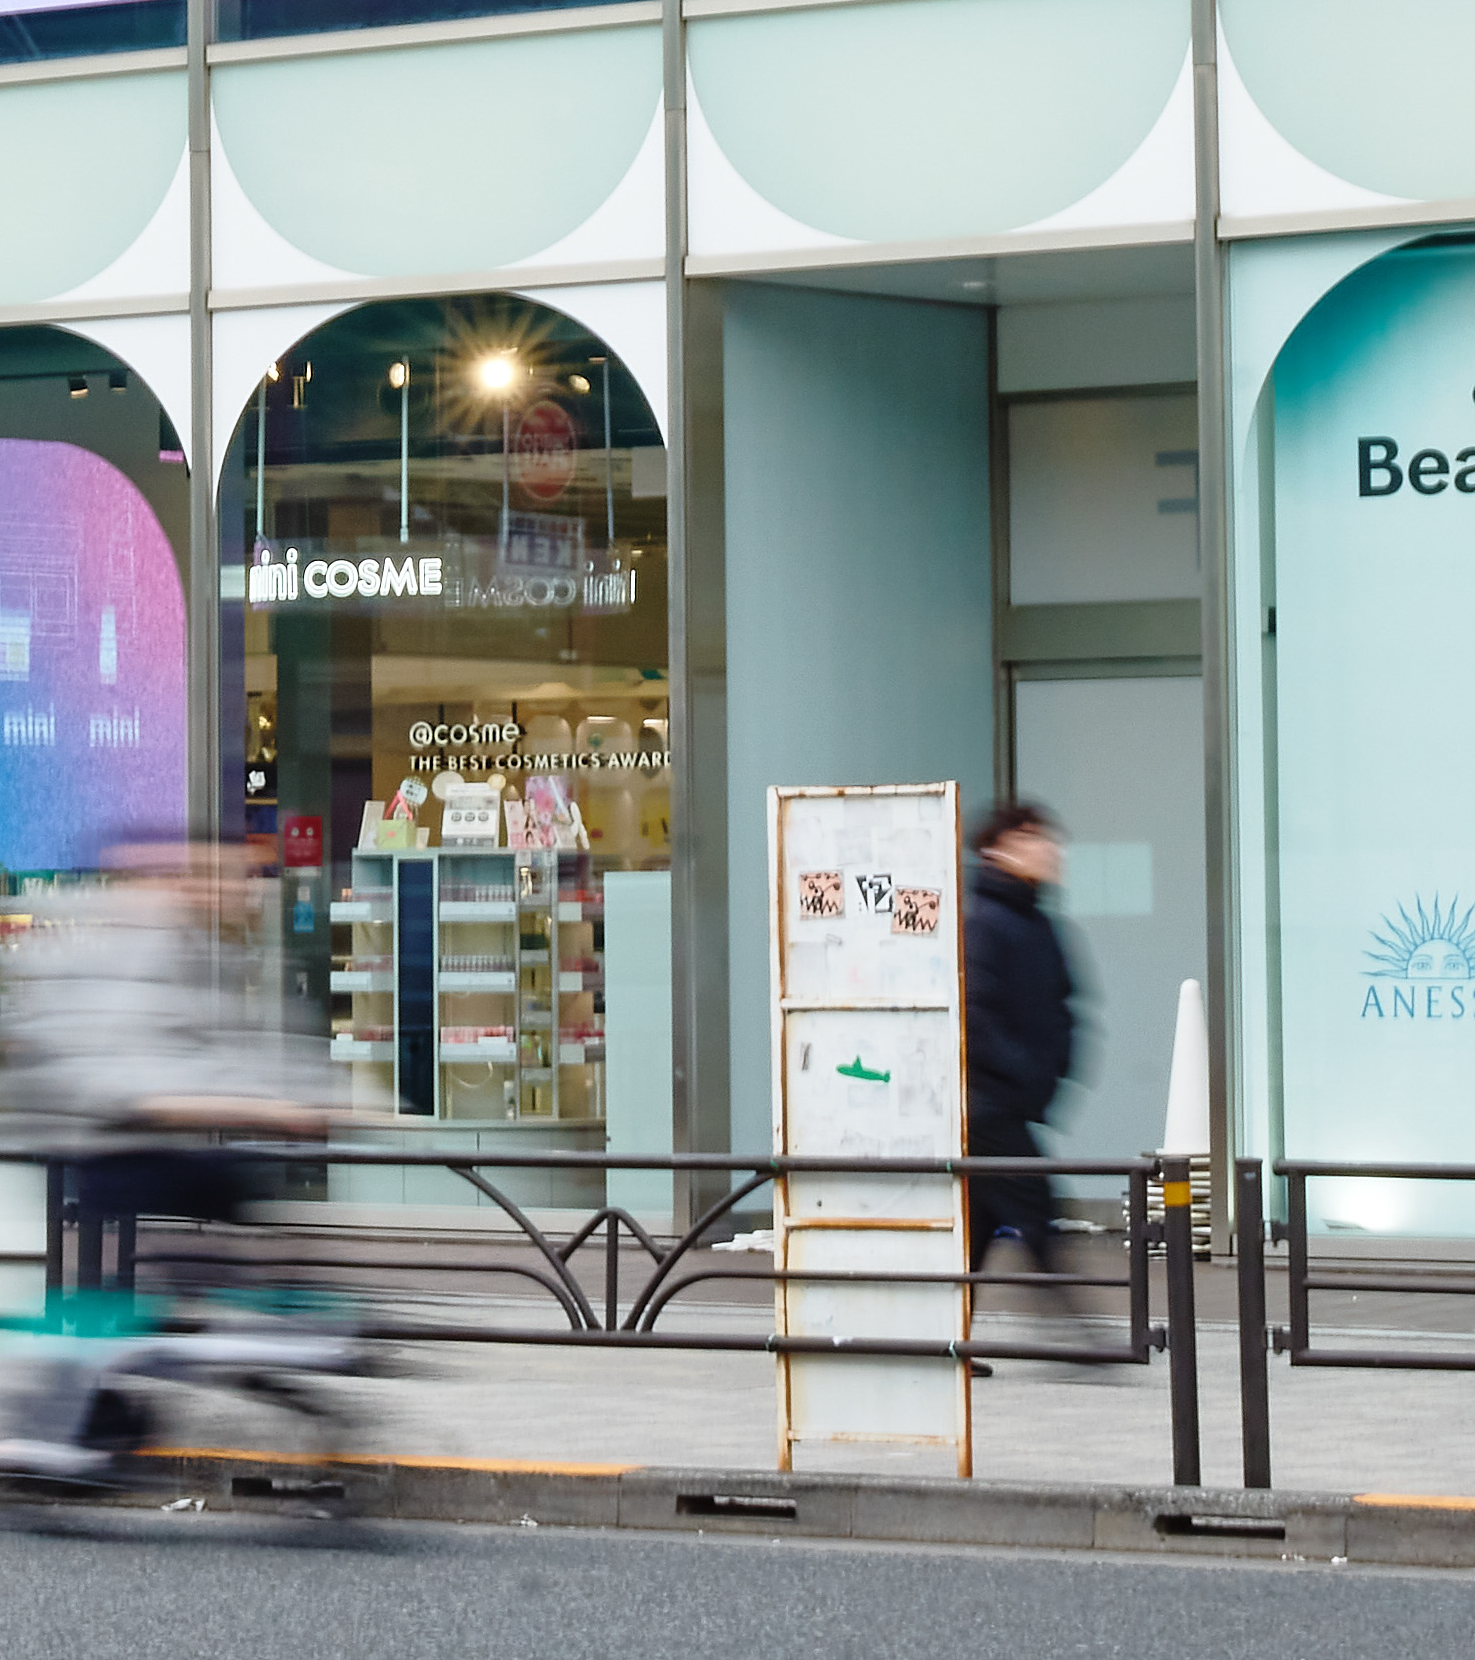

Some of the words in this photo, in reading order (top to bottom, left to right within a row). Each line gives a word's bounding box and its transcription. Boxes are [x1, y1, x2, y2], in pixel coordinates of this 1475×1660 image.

[304, 556, 443, 598] COSME
[4, 702, 56, 747] mini
[89, 704, 141, 748] mini
[409, 720, 520, 747] @cosme
[409, 755, 441, 771] THE
[448, 754, 490, 770] BEST
[495, 753, 600, 770] COSMETICS
